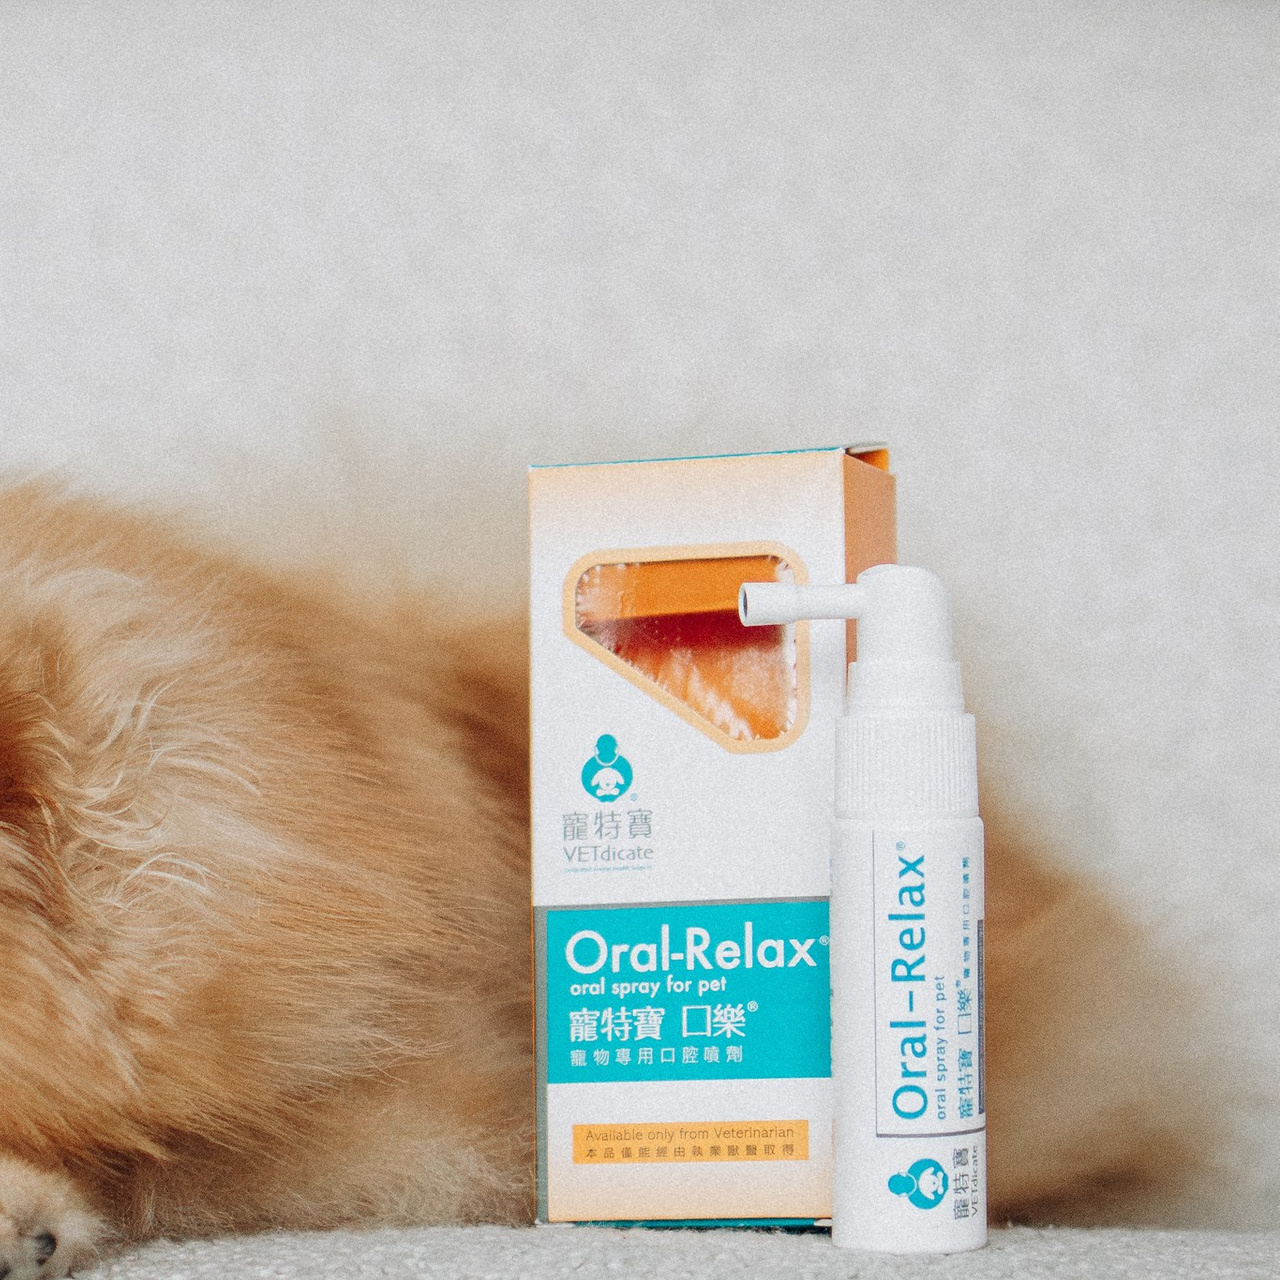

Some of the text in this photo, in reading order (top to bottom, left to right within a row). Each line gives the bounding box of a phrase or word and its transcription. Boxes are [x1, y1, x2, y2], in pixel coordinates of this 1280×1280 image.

[562, 808, 653, 841] 寵特寶
[563, 845, 654, 862] VETdicate
[570, 974, 727, 999] oral spray for pet
[570, 1005, 665, 1042] 寵特寶
[570, 1045, 743, 1067] 寵物專用口腔噴劑
[934, 975, 948, 1120] oral spray for pet
[585, 1126, 795, 1143] Available only from Veterinarian
[952, 1148, 969, 1220] 寵特寶
[971, 1145, 979, 1217] VETdicate
